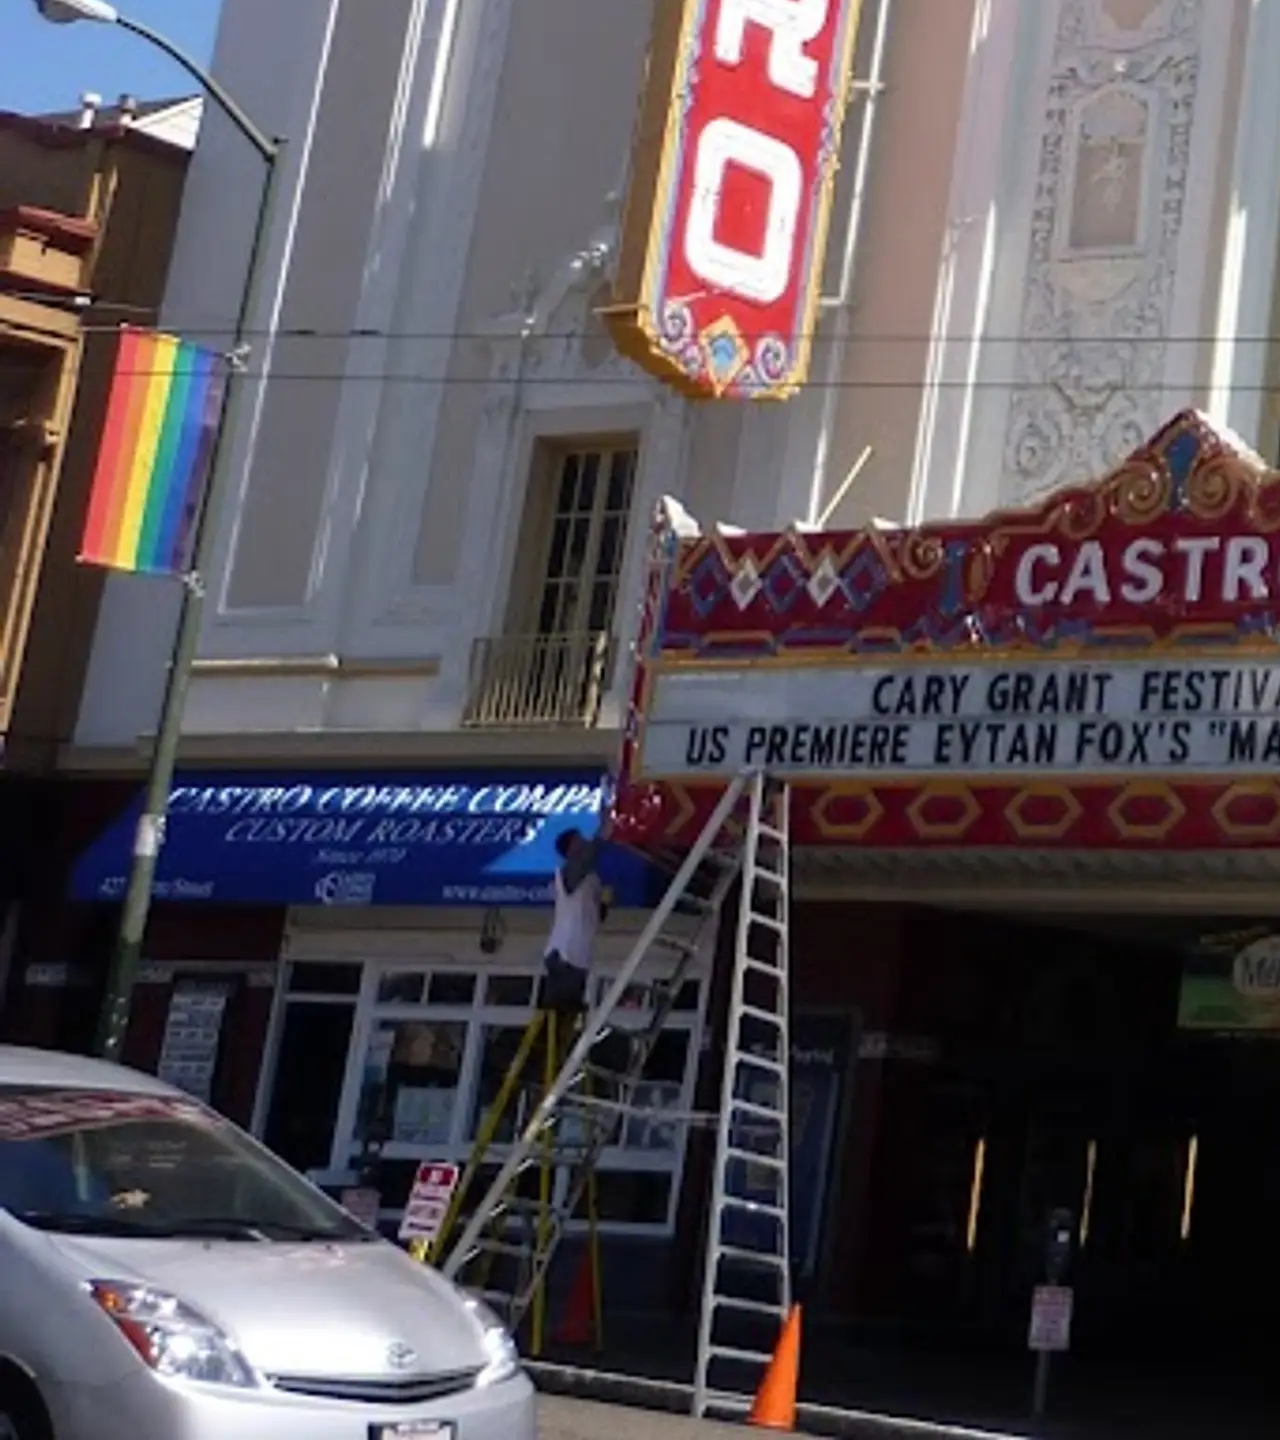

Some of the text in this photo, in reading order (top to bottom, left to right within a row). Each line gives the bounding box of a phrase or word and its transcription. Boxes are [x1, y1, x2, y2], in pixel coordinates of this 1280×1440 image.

[872, 673, 967, 716] CARY
[988, 671, 1113, 713] GRANT
[686, 725, 729, 765] US
[745, 723, 909, 764] PREMIERE
[935, 721, 1055, 764] EYTAN
[1075, 720, 1190, 762] FOX'S
[167, 784, 313, 814] CASTRO
[318, 785, 467, 813] COFFEE
[226, 816, 545, 844] CUSTOM ROASTERS
